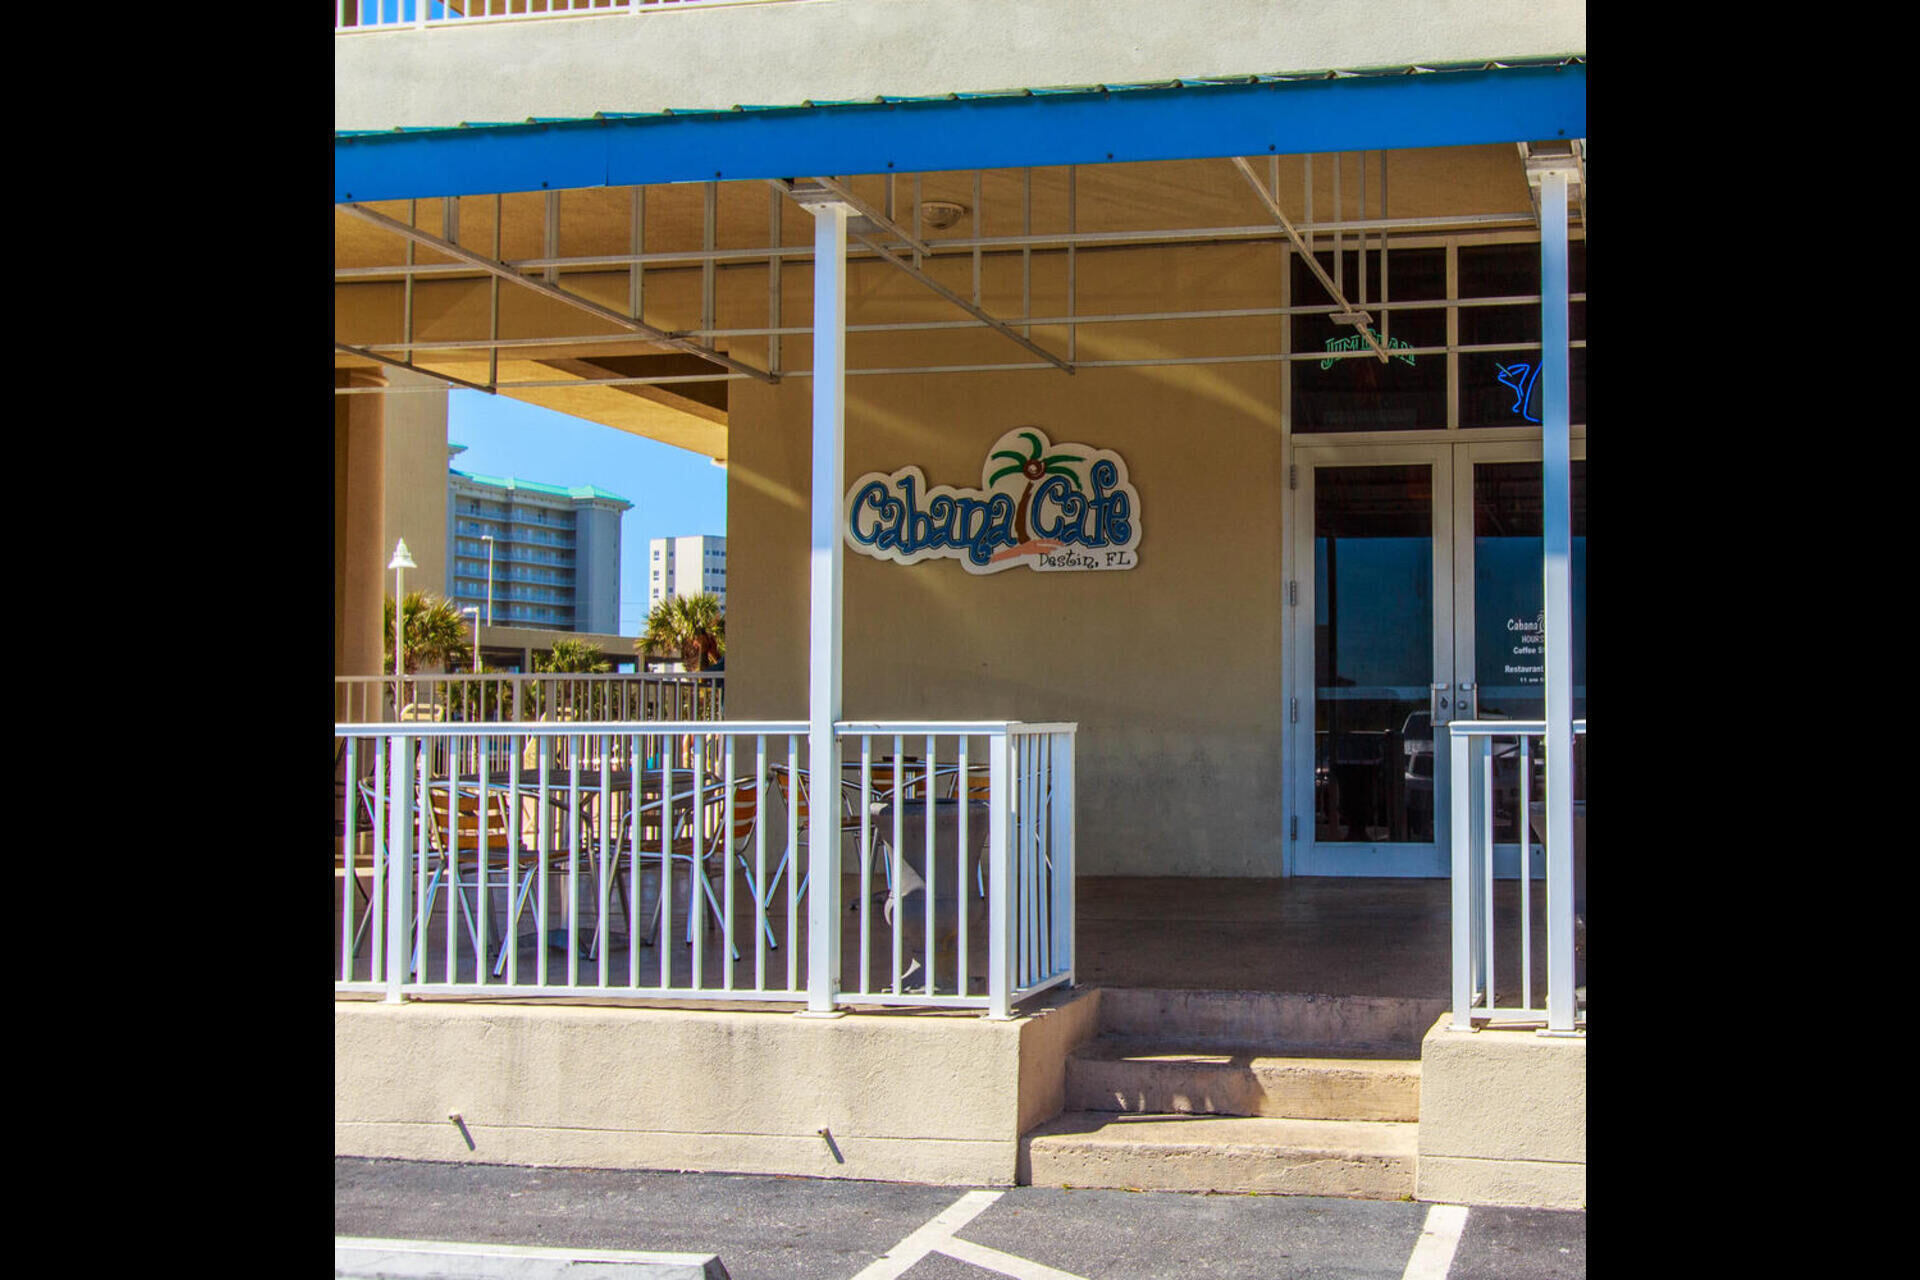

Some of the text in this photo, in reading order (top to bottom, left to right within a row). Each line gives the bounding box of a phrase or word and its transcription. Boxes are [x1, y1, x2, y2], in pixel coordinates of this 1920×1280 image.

[850, 459, 1131, 566] Cabana Cafe
[1038, 551, 1131, 569] Destin, FL
[1507, 618, 1538, 631] Cabana
[1513, 646, 1537, 654] Coffee
